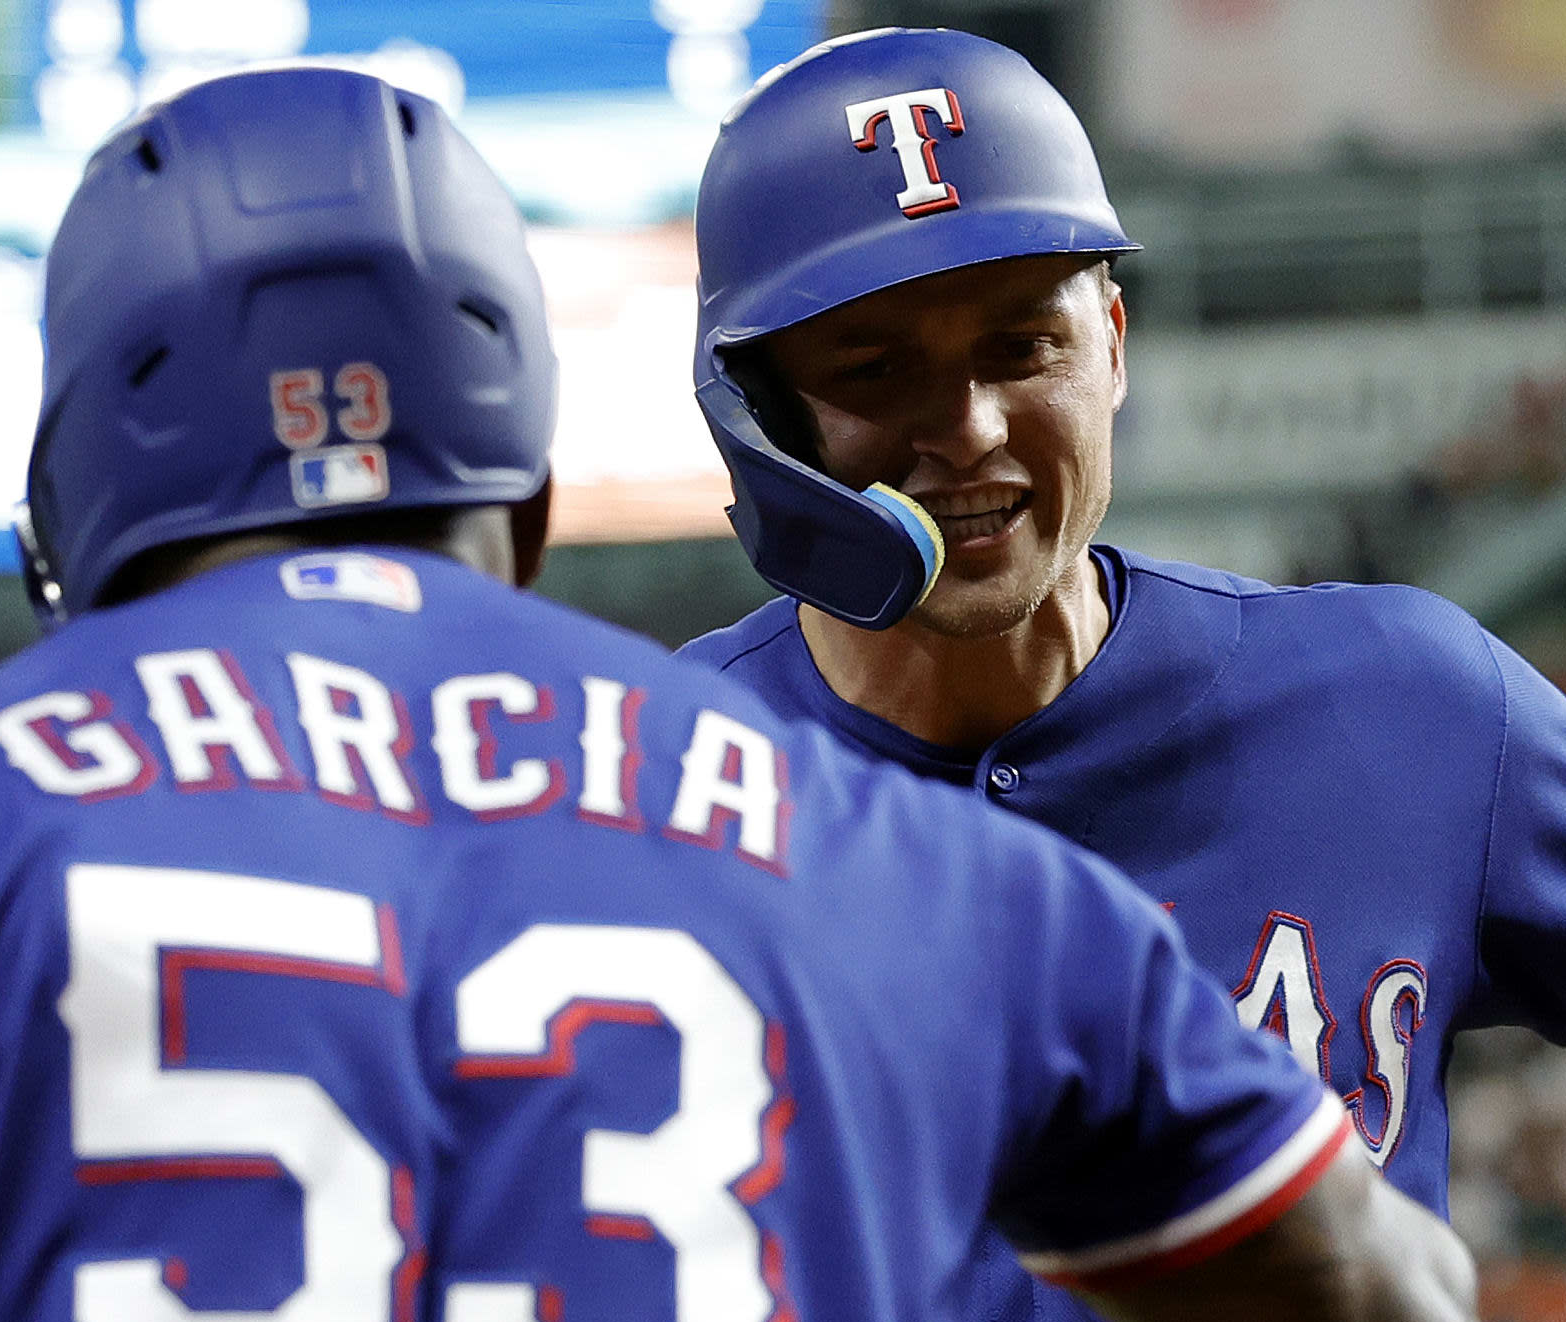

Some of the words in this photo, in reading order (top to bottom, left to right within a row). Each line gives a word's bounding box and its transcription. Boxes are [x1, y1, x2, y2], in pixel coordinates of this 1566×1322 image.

[845, 88, 966, 220] T
[269, 362, 392, 451] 53
[1161, 902, 1428, 1178] AS
